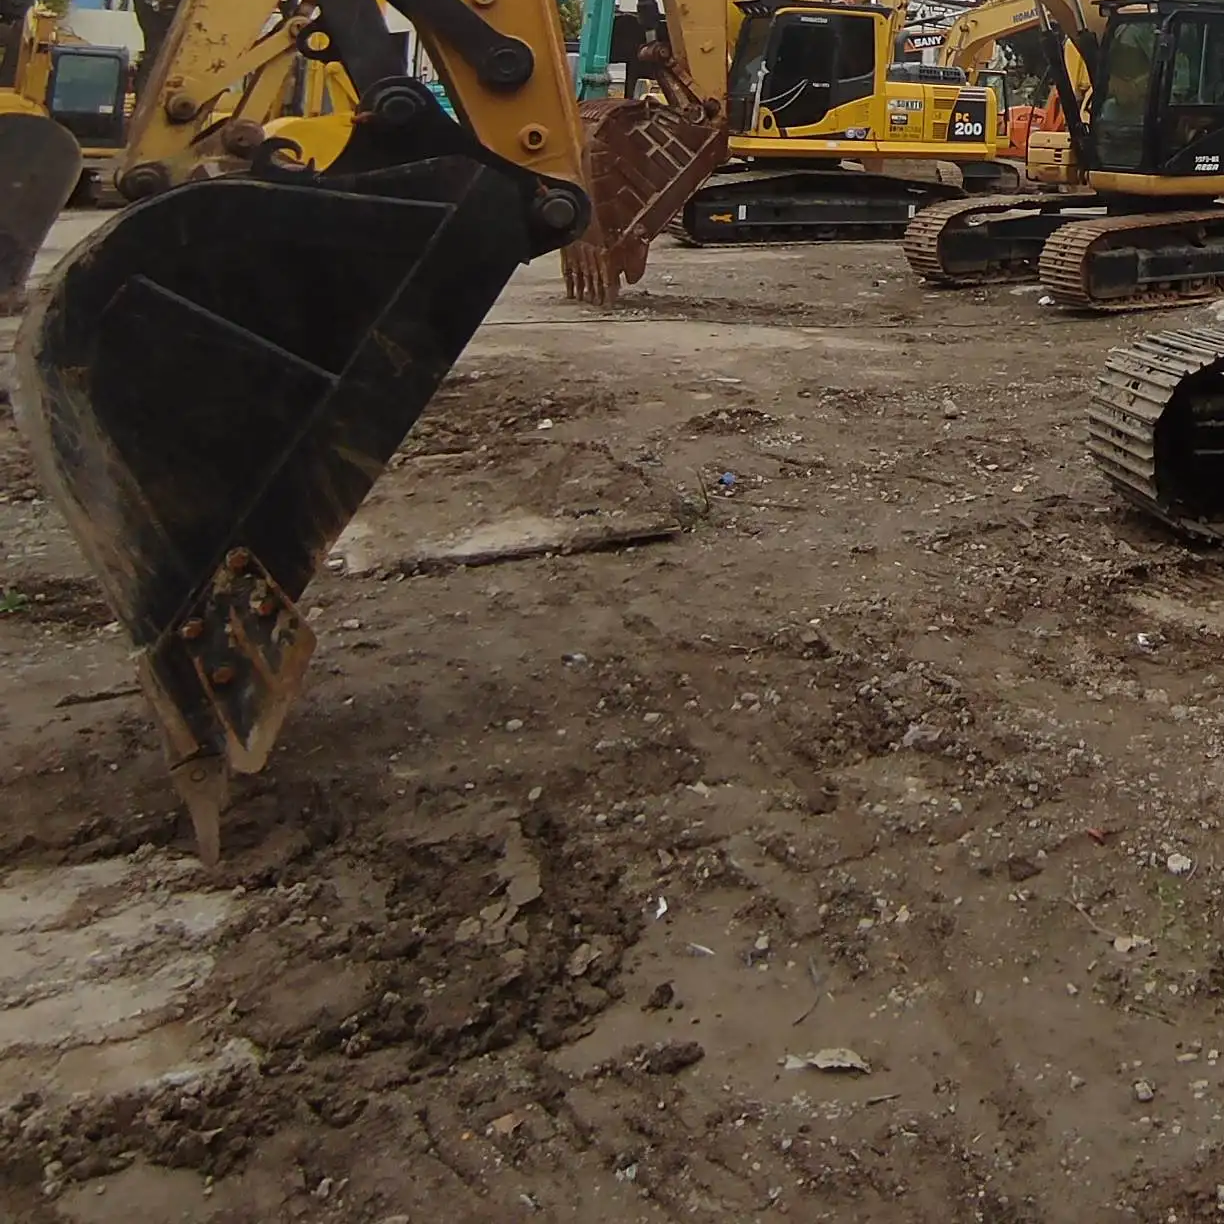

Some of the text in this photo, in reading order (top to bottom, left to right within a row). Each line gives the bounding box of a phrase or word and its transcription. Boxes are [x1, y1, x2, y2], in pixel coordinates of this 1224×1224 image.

[913, 35, 942, 49] SANY
[955, 112, 970, 123] PC
[954, 122, 983, 136] 200
